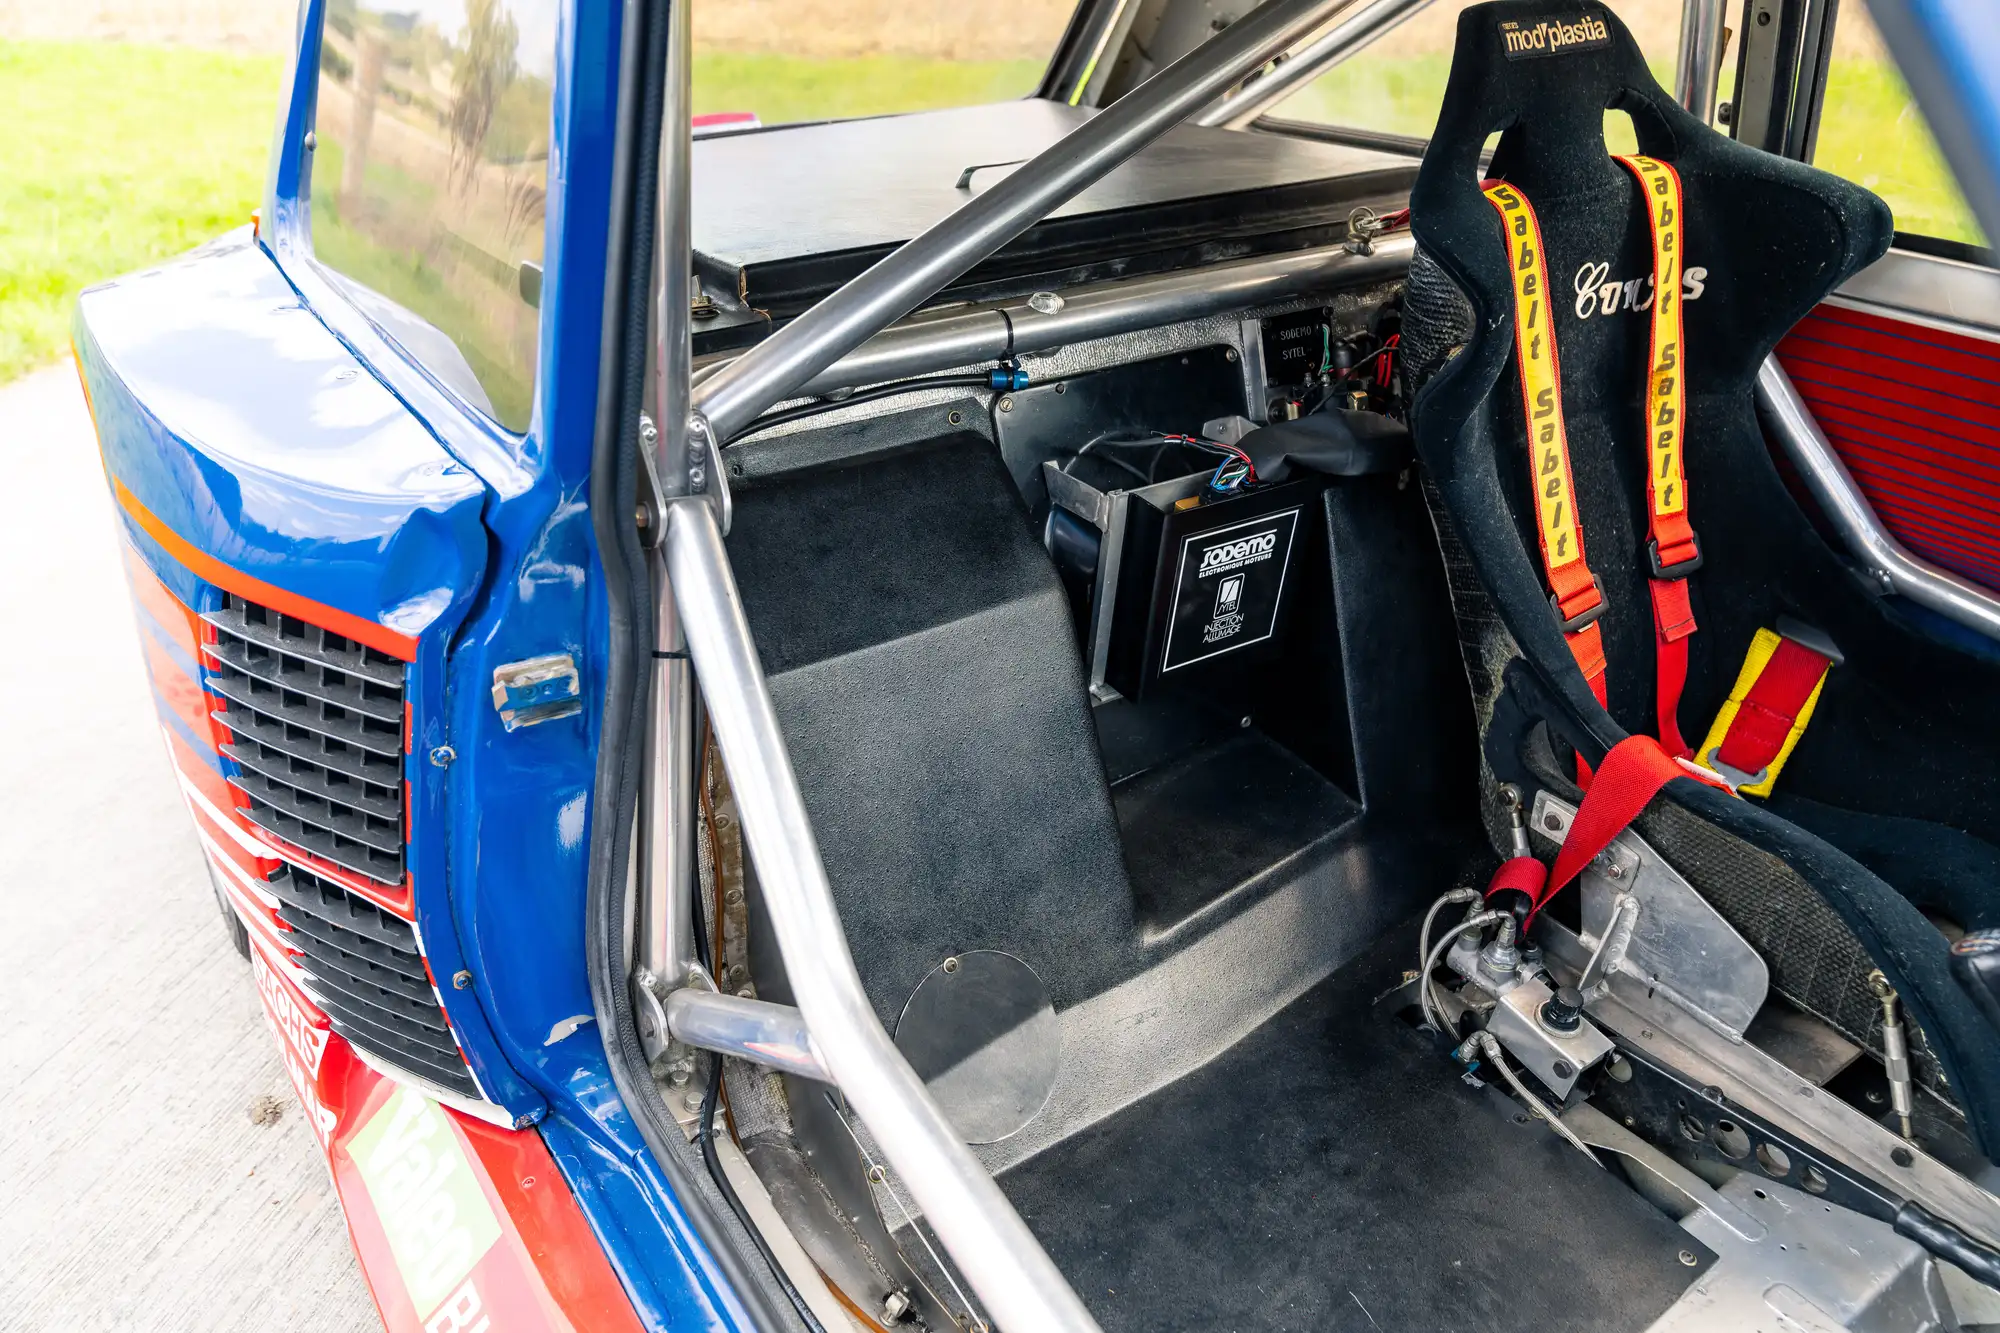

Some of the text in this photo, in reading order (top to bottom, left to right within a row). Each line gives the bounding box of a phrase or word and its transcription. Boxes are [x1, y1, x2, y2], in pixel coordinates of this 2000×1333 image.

[1491, 186, 1541, 361] Sabelt
[1634, 155, 1674, 315] Sabelt
[1280, 325, 1312, 341] SODEMO
[1282, 346, 1307, 361] SYTEL
[1534, 387, 1568, 557] Sabelt
[1657, 342, 1677, 508] Sabelt
[1198, 552, 1272, 579] ELECTRONIQUE MOTEURS
[1204, 612, 1244, 633] INJECTION
[1202, 623, 1242, 643] ALLUMAGE
[253, 947, 319, 1069] SACHS
[368, 1086, 473, 1299] Valeo
